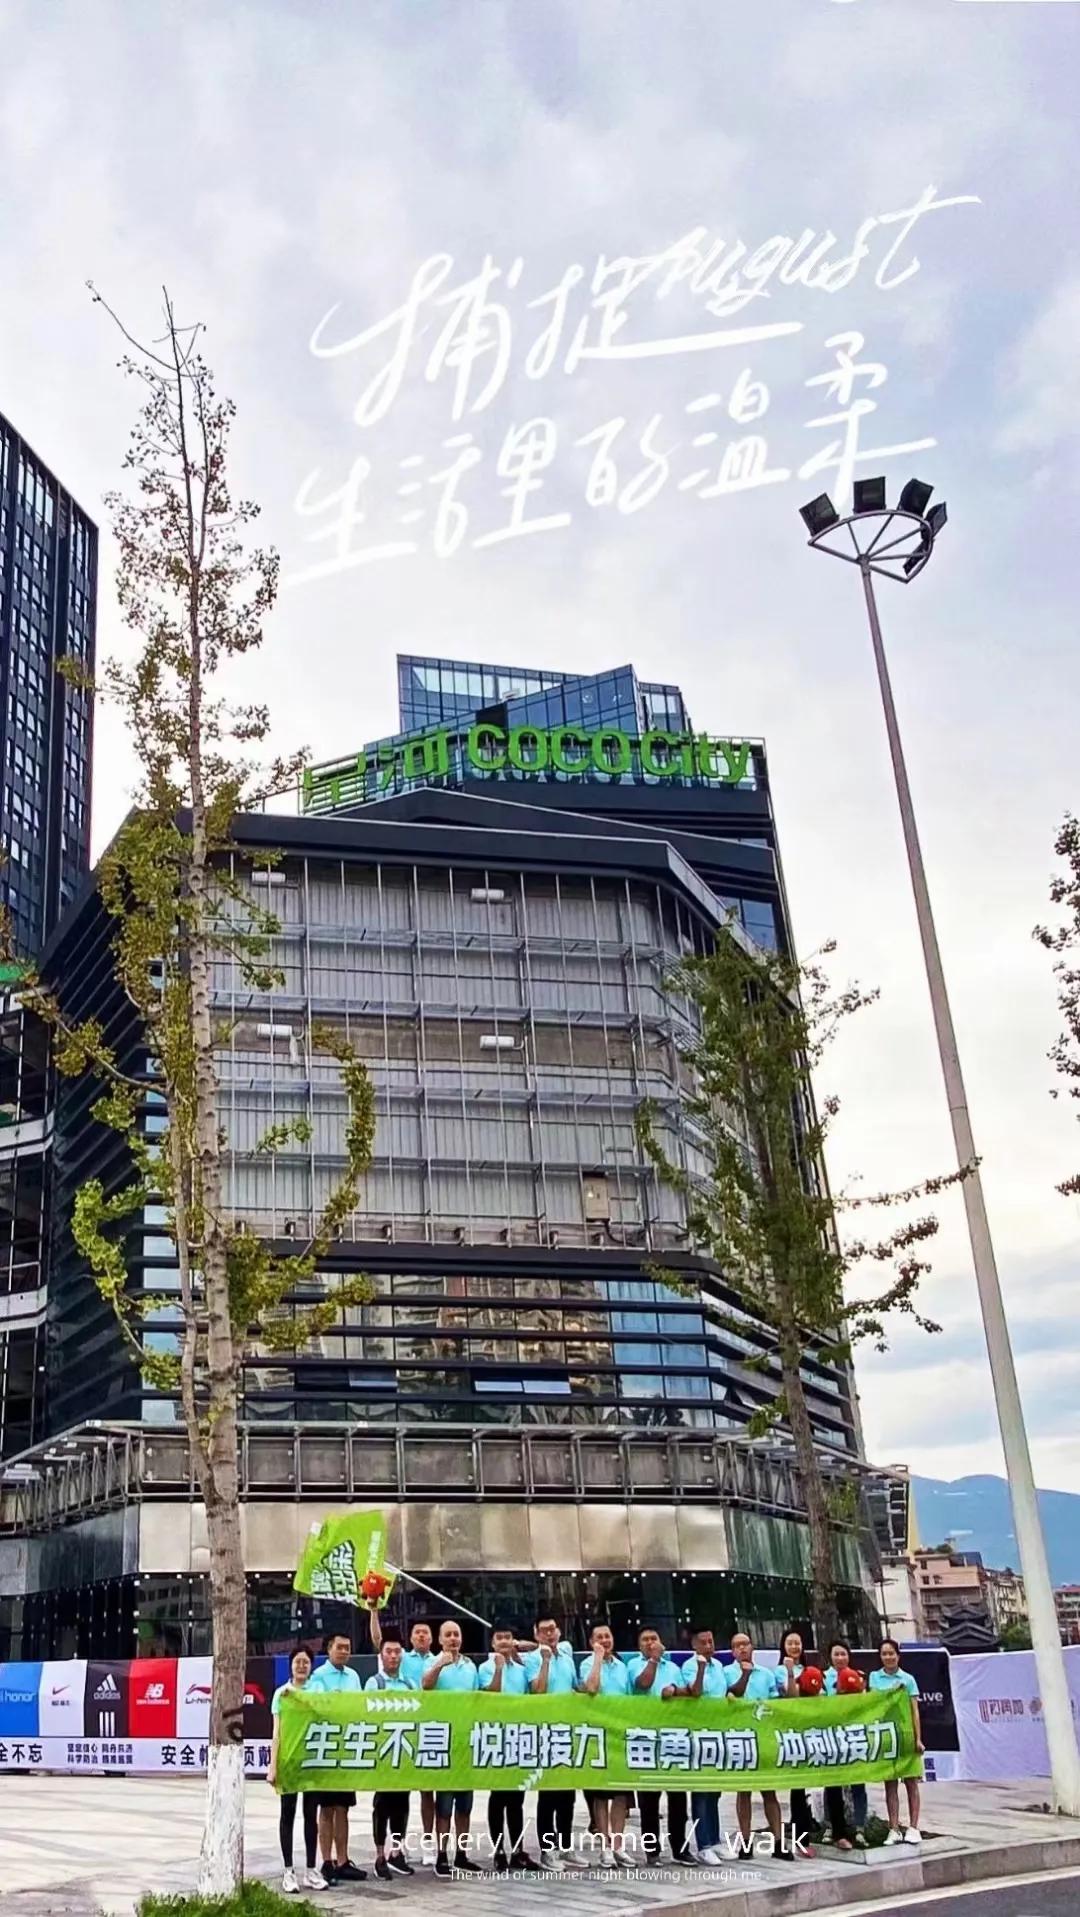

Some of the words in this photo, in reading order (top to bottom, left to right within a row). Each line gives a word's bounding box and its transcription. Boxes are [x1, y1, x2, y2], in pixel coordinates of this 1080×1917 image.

[640, 729, 751, 785] City
[4, 1690, 35, 1702] honor
[93, 1691, 121, 1700] adidas
[302, 1721, 451, 1769] 生生不息
[470, 1721, 607, 1769] 悦跑接力
[625, 1727, 759, 1771] 奋勇向前
[775, 1721, 899, 1769] 冲刺接力
